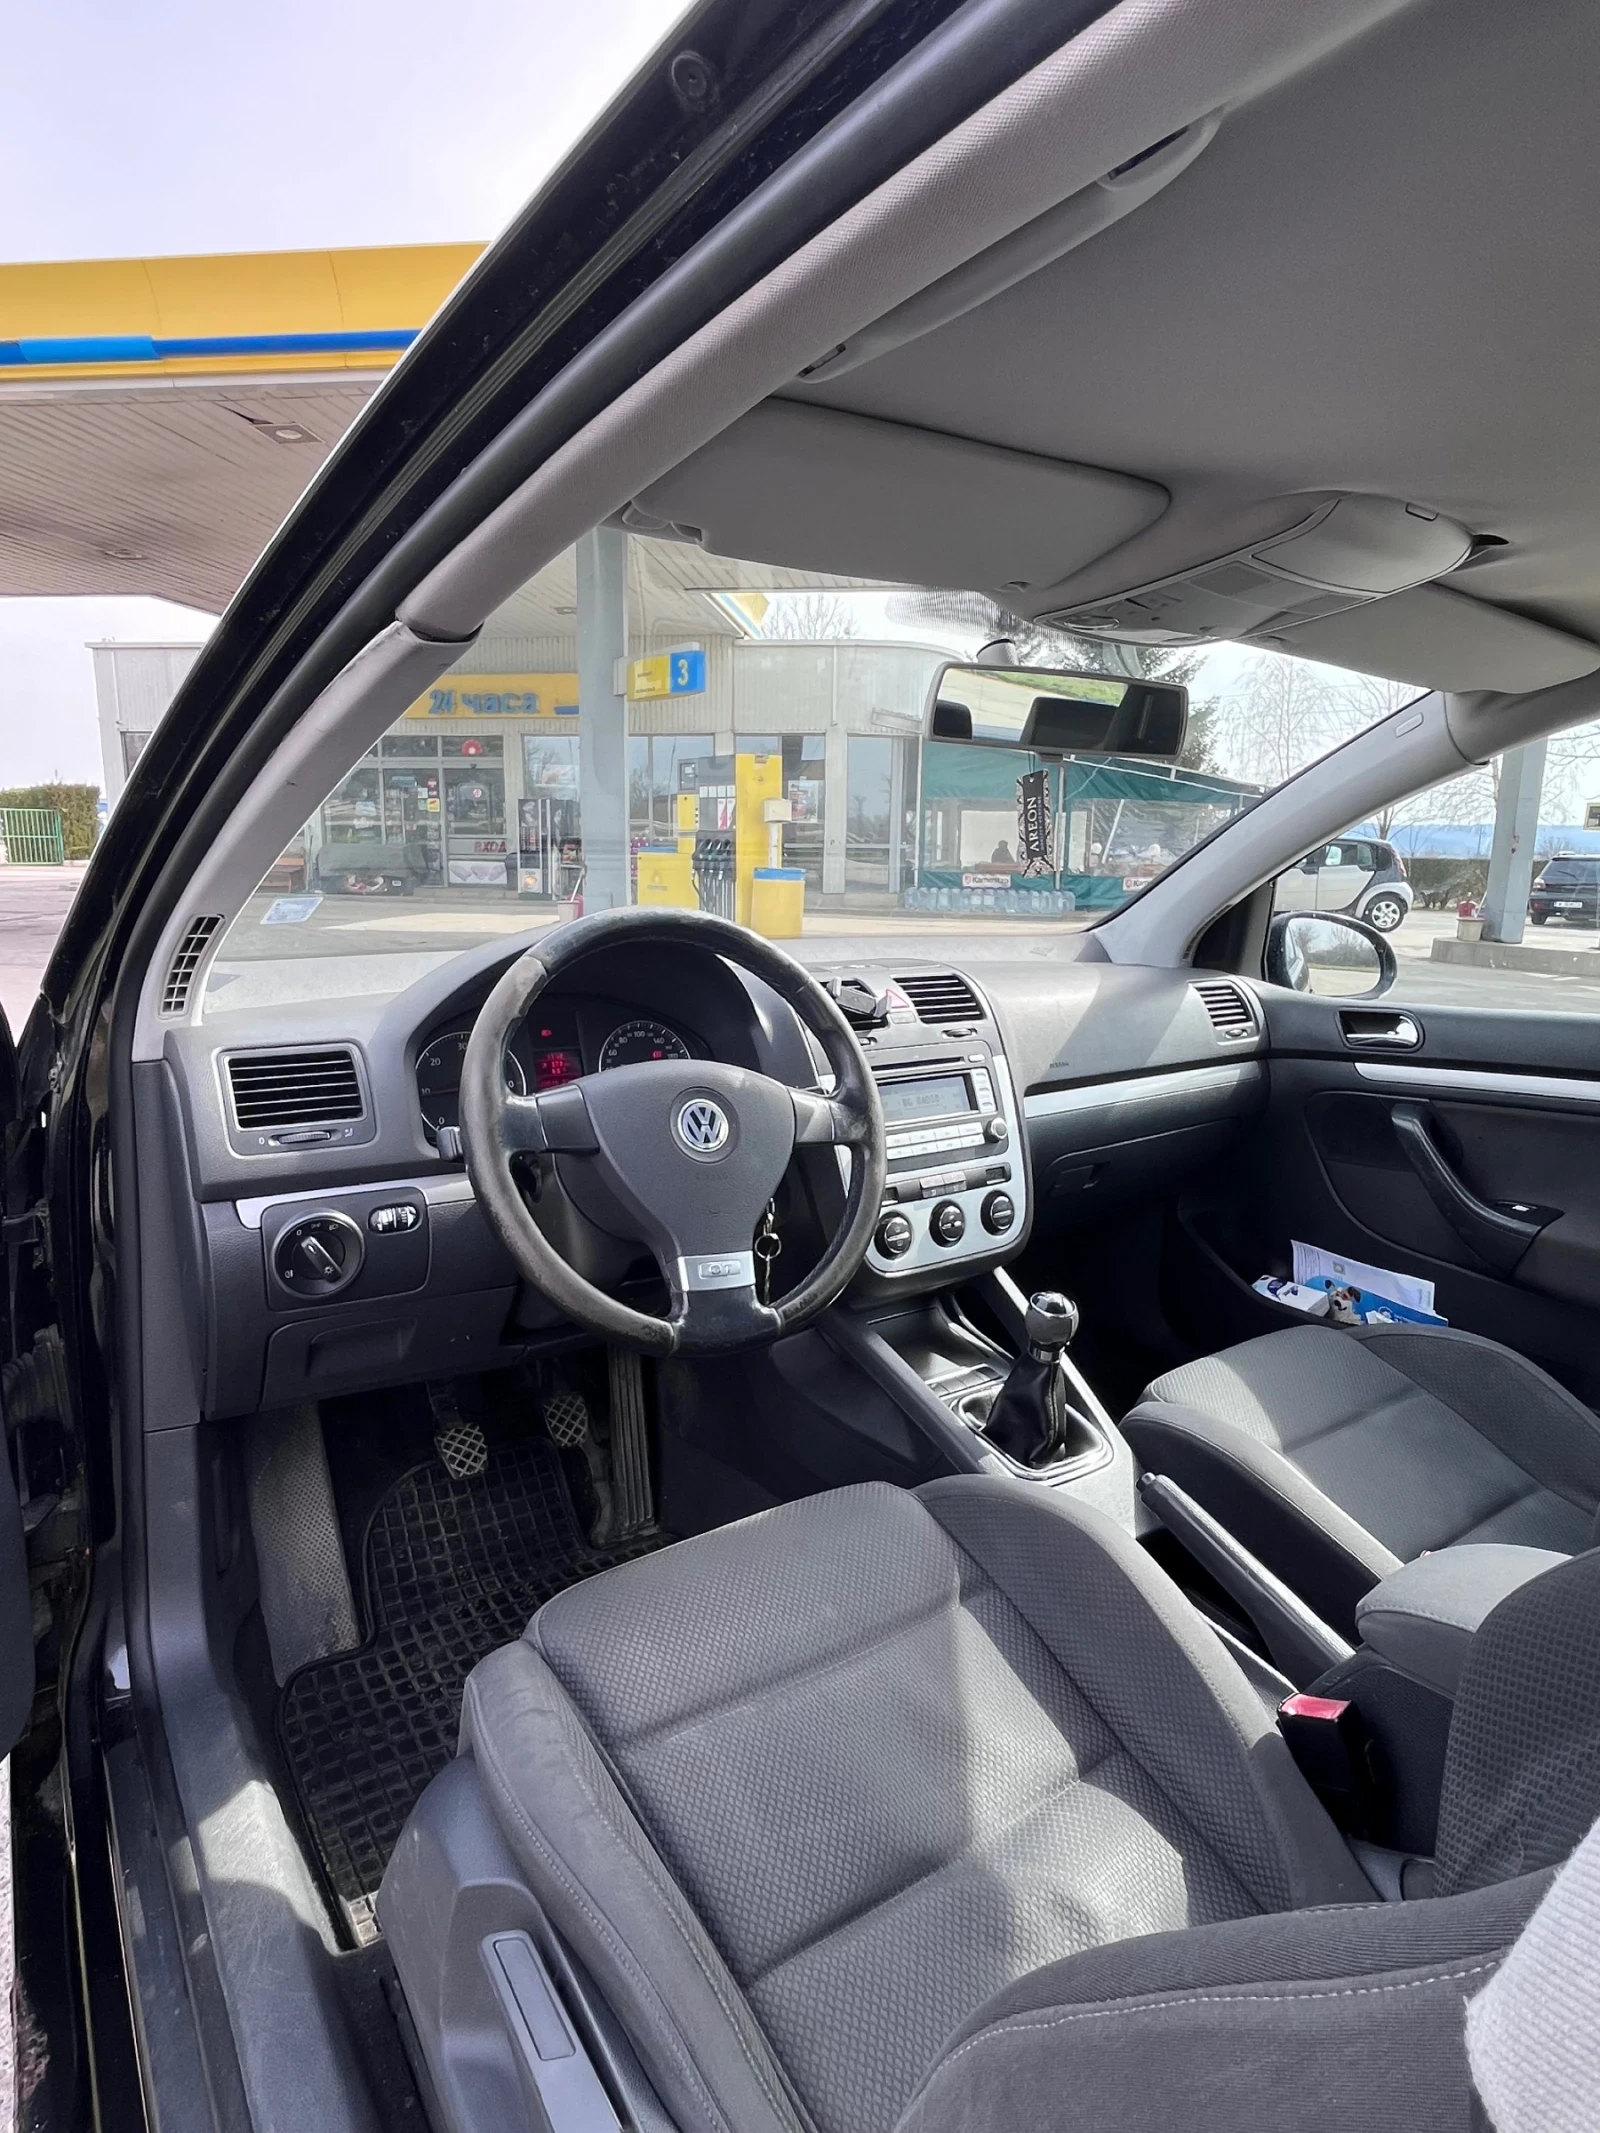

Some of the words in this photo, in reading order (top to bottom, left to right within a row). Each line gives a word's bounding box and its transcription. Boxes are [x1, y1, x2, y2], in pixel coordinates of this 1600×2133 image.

[677, 659, 689, 686] 3
[428, 689, 457, 715] 24
[1026, 796, 1040, 852] AREON
[474, 841, 507, 853] ВХОД
[430, 1057, 441, 1067] 20
[438, 1116, 445, 1125] 0
